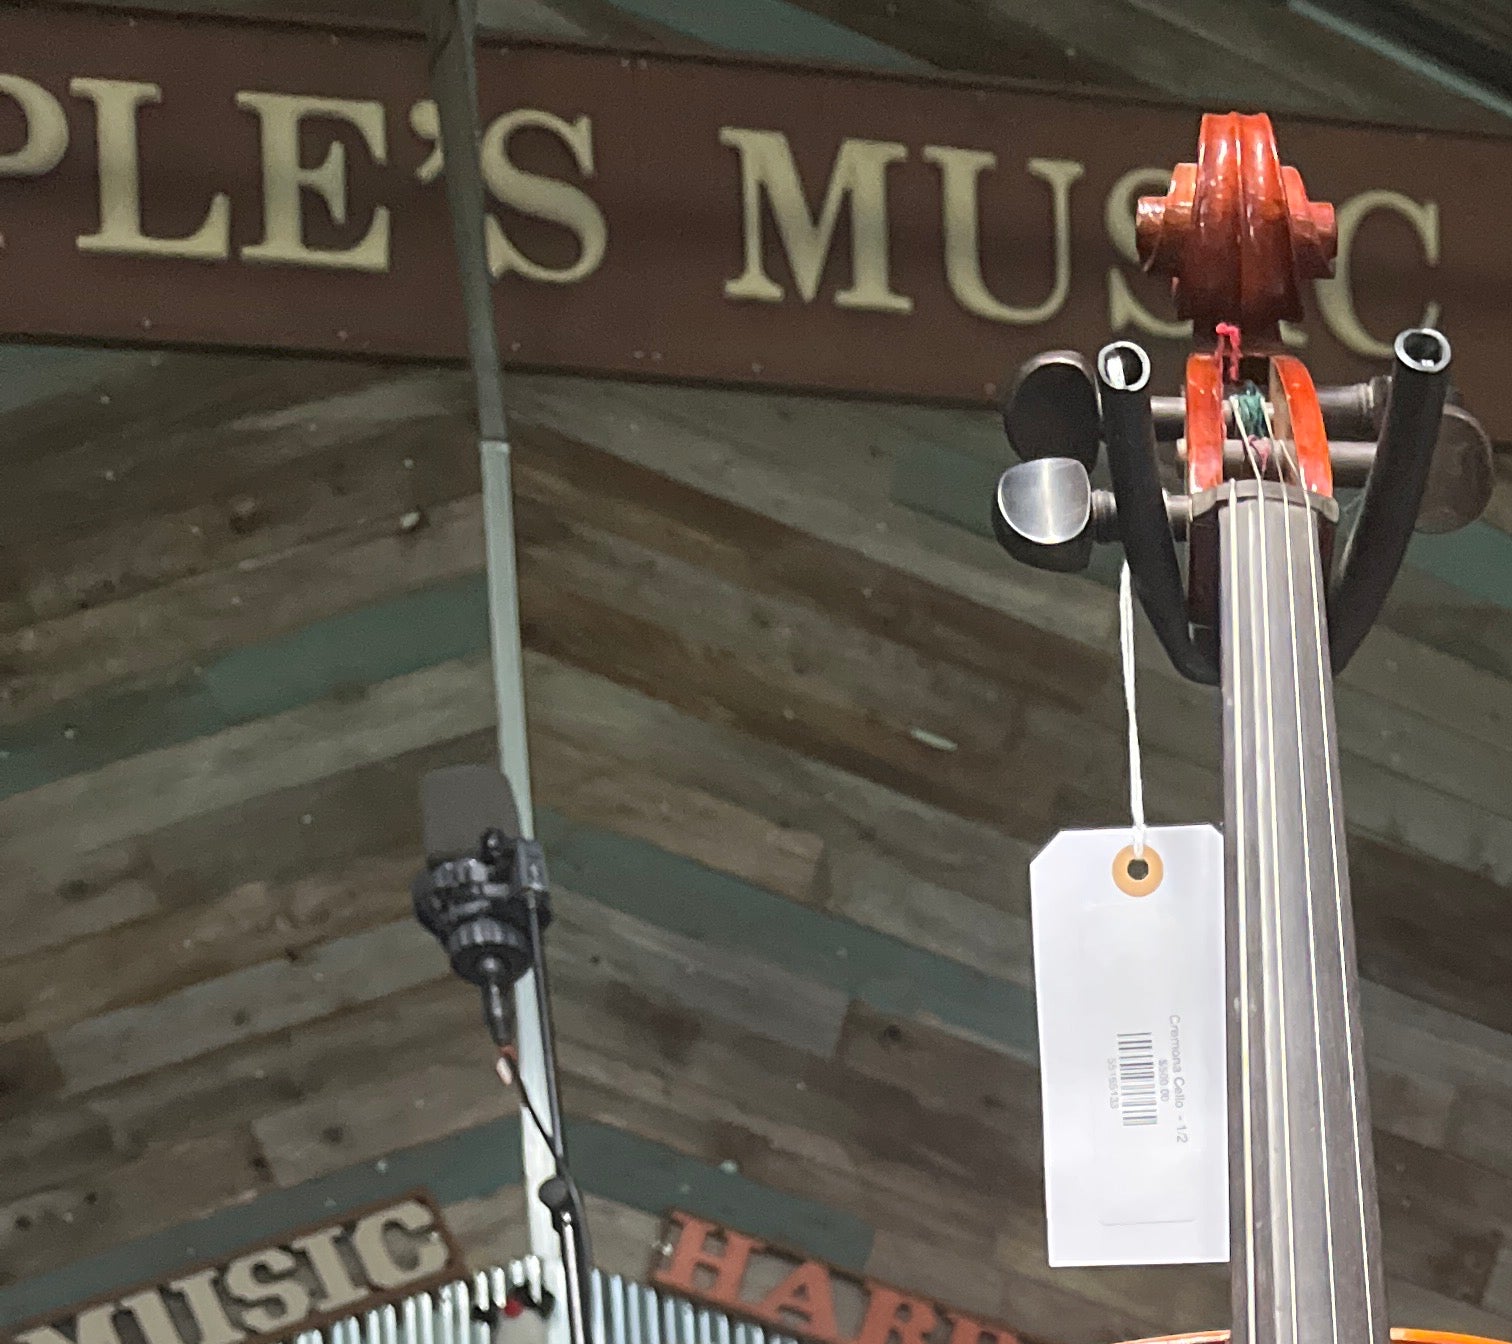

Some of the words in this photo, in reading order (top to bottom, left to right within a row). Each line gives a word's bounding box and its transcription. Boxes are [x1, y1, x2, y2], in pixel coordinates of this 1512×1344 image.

[718, 127, 1442, 358] MUSC
[1169, 1014, 1182, 1073] Cremona
[1173, 1077, 1185, 1109] Cello
[1176, 1125, 1188, 1143] 1/2
